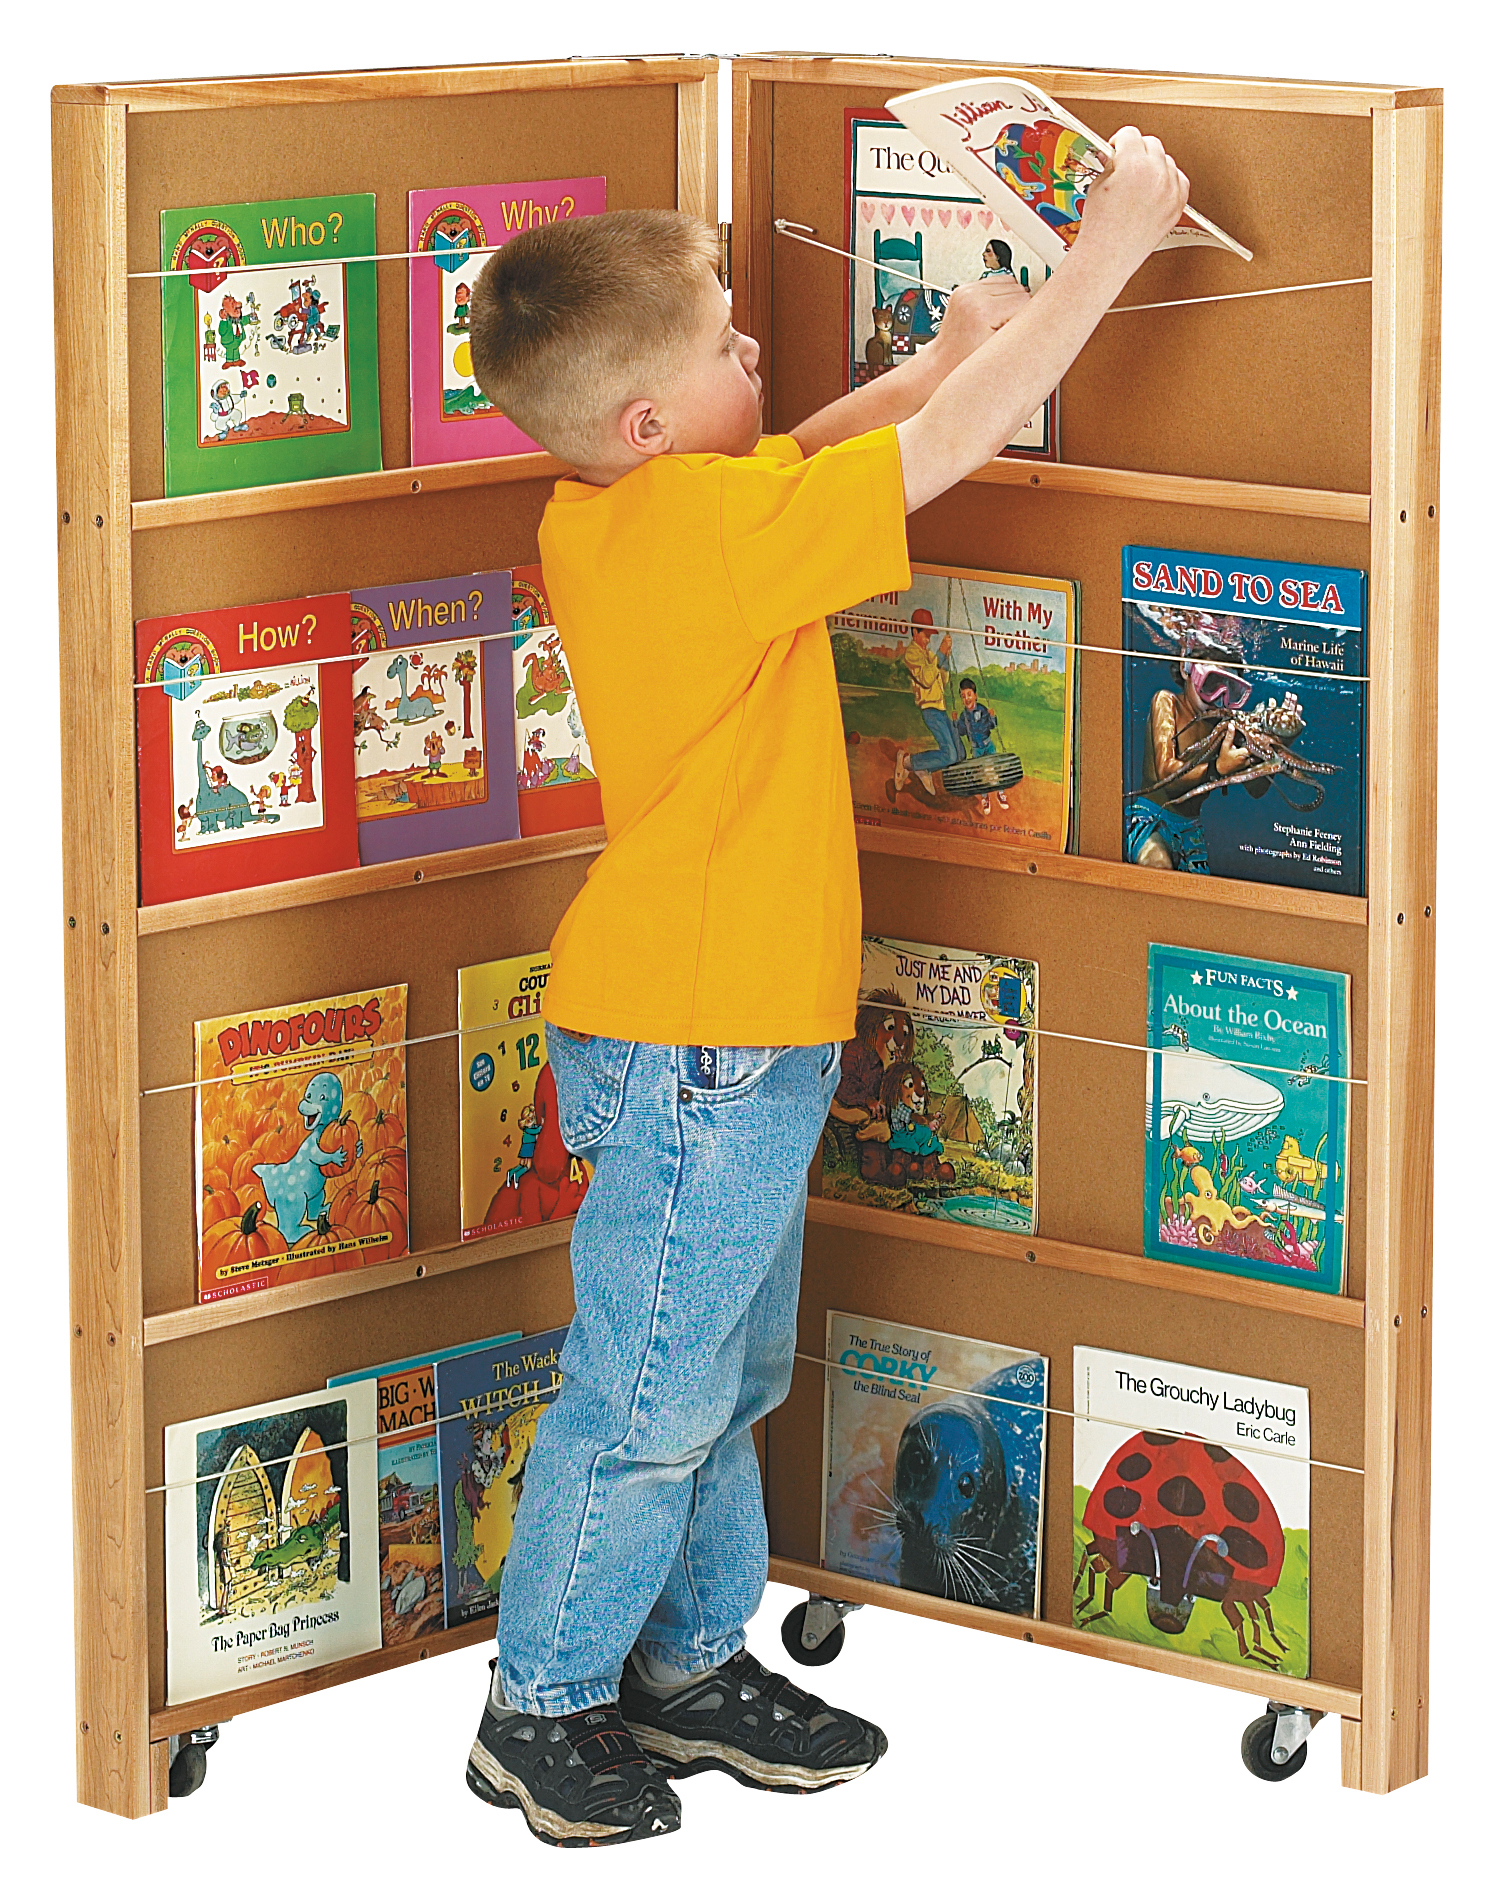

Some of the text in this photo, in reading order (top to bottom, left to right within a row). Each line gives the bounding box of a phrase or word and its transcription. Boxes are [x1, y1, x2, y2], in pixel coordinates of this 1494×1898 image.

[869, 146, 915, 172] The
[261, 211, 344, 250] Who?
[1133, 561, 1345, 614] SAND TO SEA
[388, 589, 484, 632] When?
[983, 595, 1053, 630] With My
[239, 614, 318, 654] How?
[984, 625, 1049, 654] Brother
[1280, 636, 1345, 656] Marine Life
[1290, 653, 1345, 672] of Hawaii
[1273, 821, 1342, 844] Stephanie Feeney
[1289, 837, 1342, 856] Ann Fielding
[1239, 844, 1254, 853] with
[1254, 846, 1293, 858] photographs
[1293, 850, 1301, 861] by
[1302, 852, 1311, 862] Ed
[1313, 865, 1324, 874] and
[519, 973, 551, 992] COU
[895, 955, 982, 984] JUST ME AND
[1205, 968, 1284, 997] FUN FACTS
[492, 999, 499, 1011] 3
[916, 982, 972, 1007] MY DAD
[1163, 993, 1327, 1039] About the Ocean
[217, 998, 382, 1067] DINOFOURS
[516, 1033, 540, 1071] 12
[503, 1134, 512, 1148] 4
[493, 1157, 502, 1172] 2
[569, 1157, 583, 1185] 4
[471, 1216, 523, 1236] SCHOLASTIC
[219, 1267, 228, 1277] by
[230, 1262, 250, 1274] Steve
[251, 1256, 280, 1271] Metzger
[286, 1246, 326, 1262] Illustrated
[327, 1244, 336, 1254] by
[338, 1240, 357, 1251] Hans
[212, 1279, 266, 1300] SCHOLASTIC
[849, 1334, 932, 1363] The True Story of
[492, 1347, 562, 1381] The Wack
[839, 1349, 938, 1391] CORKY
[378, 1382, 409, 1410] BIG
[459, 1379, 540, 1421] WITCH
[853, 1380, 921, 1404] the Blind Seal
[1115, 1370, 1147, 1394] The
[1150, 1377, 1219, 1411] Grouchy
[1223, 1391, 1296, 1426] Ladybug
[1236, 1422, 1296, 1446] Eric Carle
[211, 1610, 340, 1653] The Paper Bag Princess
[237, 1653, 257, 1664] STORY
[237, 1665, 248, 1674] ART
[252, 1658, 276, 1670] MICHAEL
